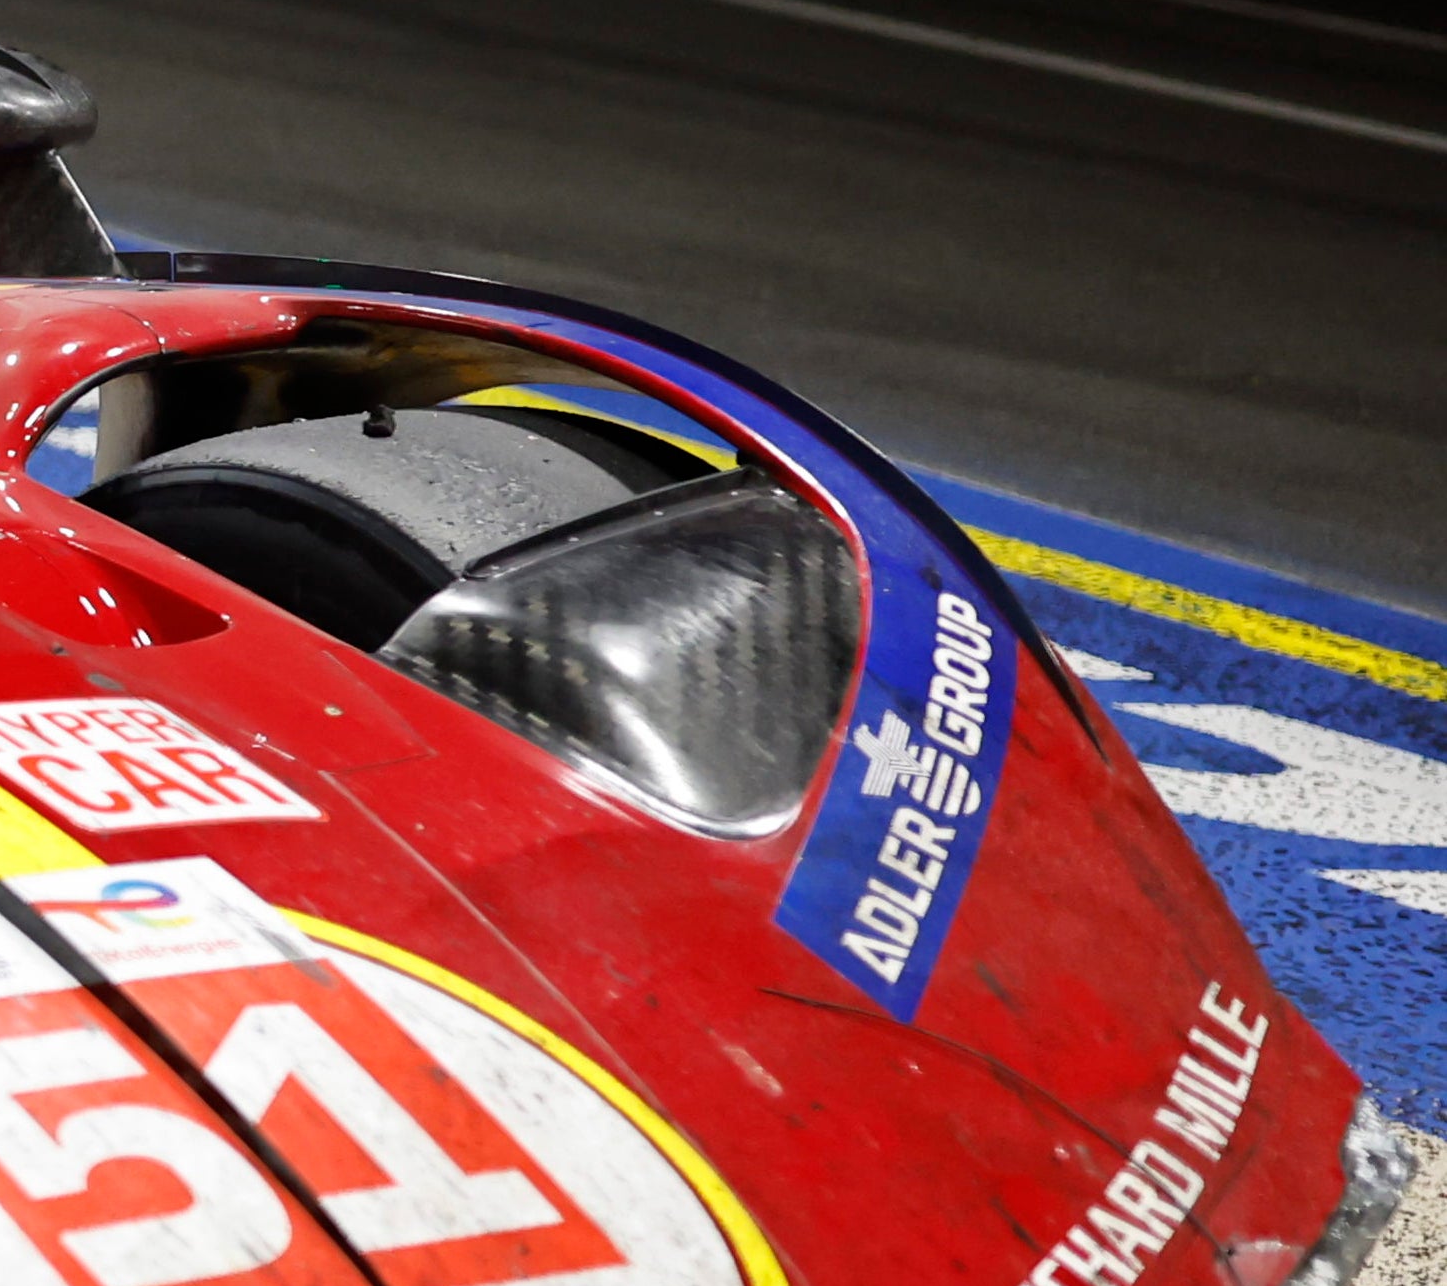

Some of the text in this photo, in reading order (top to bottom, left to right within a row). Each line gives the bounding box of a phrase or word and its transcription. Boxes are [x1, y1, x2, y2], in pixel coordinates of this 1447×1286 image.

[16, 746, 295, 815] CAR
[839, 590, 999, 985] ADLER GROUP
[1153, 980, 1271, 1161] MILLE
